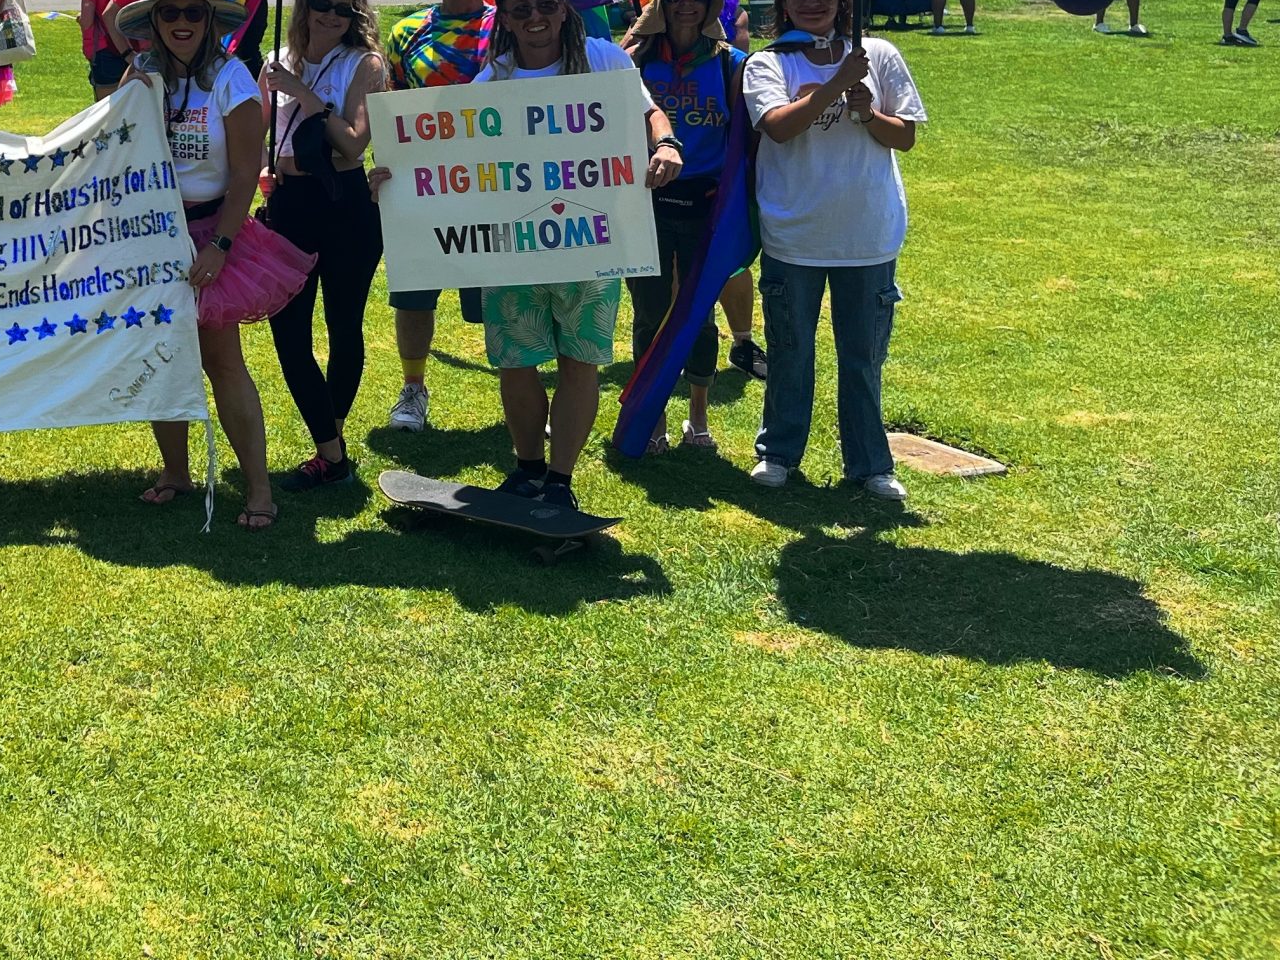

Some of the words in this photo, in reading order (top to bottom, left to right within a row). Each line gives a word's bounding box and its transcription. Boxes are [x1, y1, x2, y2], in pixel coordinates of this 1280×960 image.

[395, 106, 503, 144] LGBTQ
[526, 101, 605, 136] PLUS
[652, 94, 718, 112] EOPLE
[9, 192, 32, 219] of
[35, 175, 123, 217] Housing
[122, 165, 147, 195] for
[148, 160, 178, 190] All
[414, 161, 532, 197] RIGHTS
[543, 155, 635, 191] BEGIN
[108, 208, 177, 244] Housing
[433, 222, 511, 254] WITH
[514, 214, 611, 252] HOME
